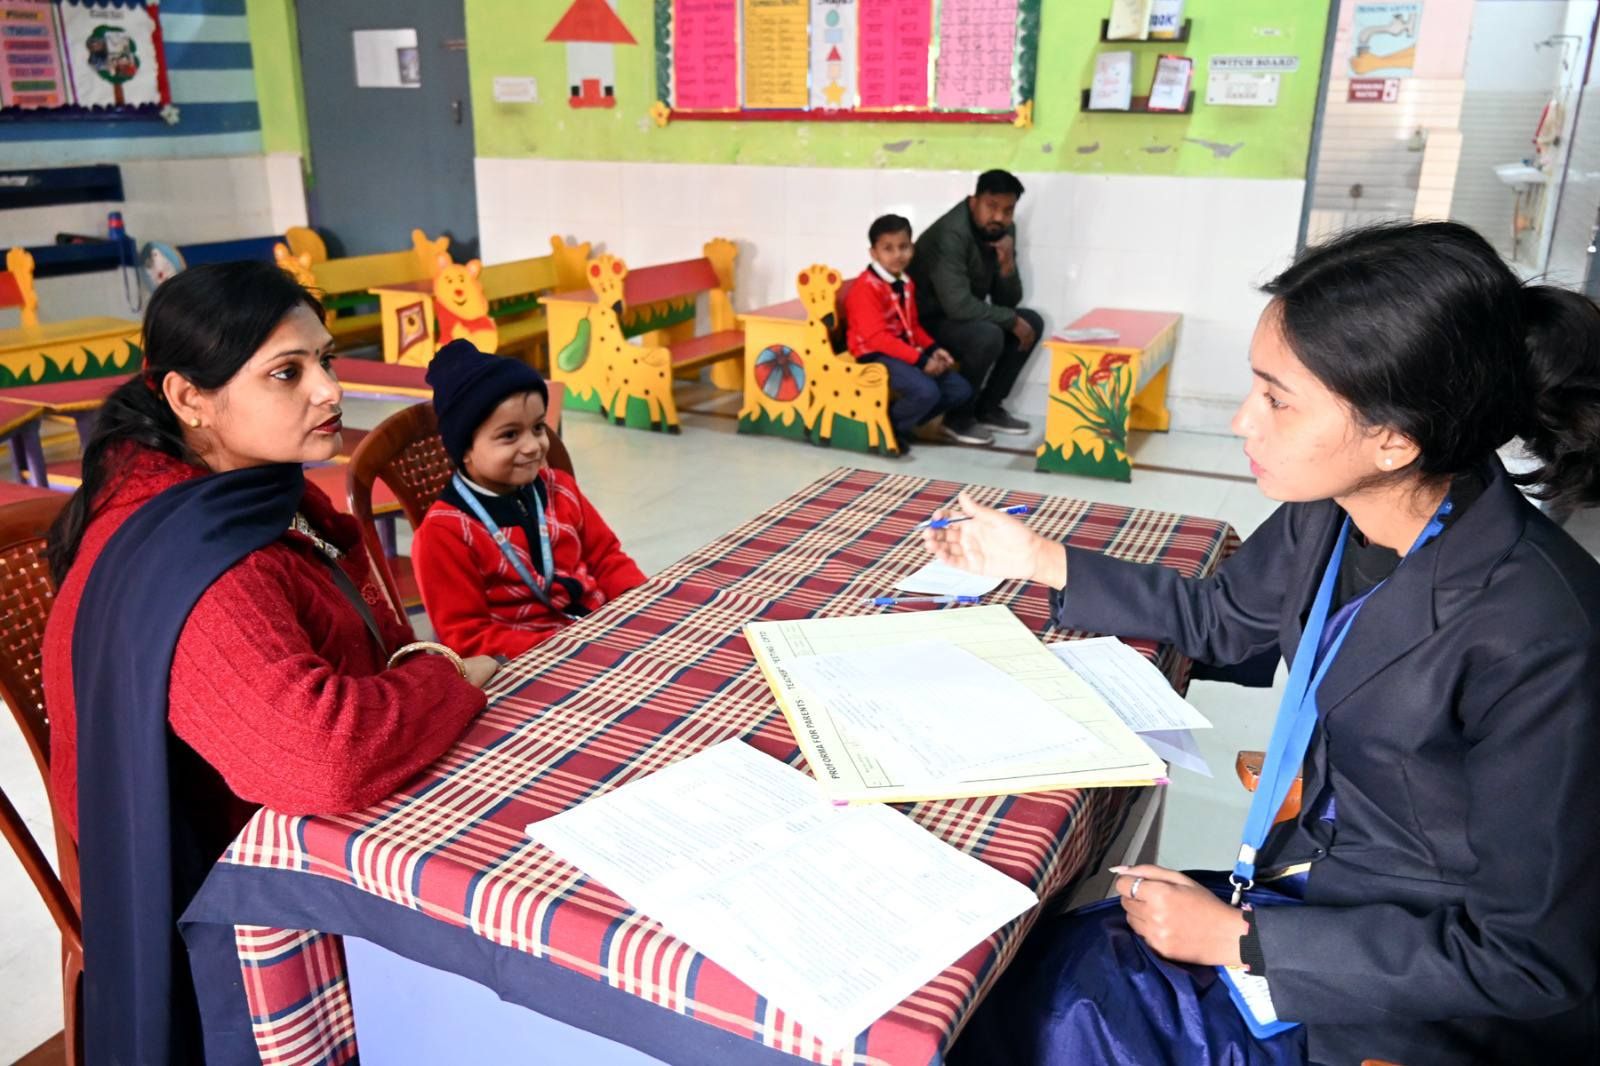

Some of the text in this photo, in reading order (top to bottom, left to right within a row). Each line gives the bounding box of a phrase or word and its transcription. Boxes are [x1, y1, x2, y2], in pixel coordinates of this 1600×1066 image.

[1212, 58, 1294, 67] SWITCH BOARD
[809, 729, 821, 744] FOR
[816, 743, 841, 779] PROFORMA
